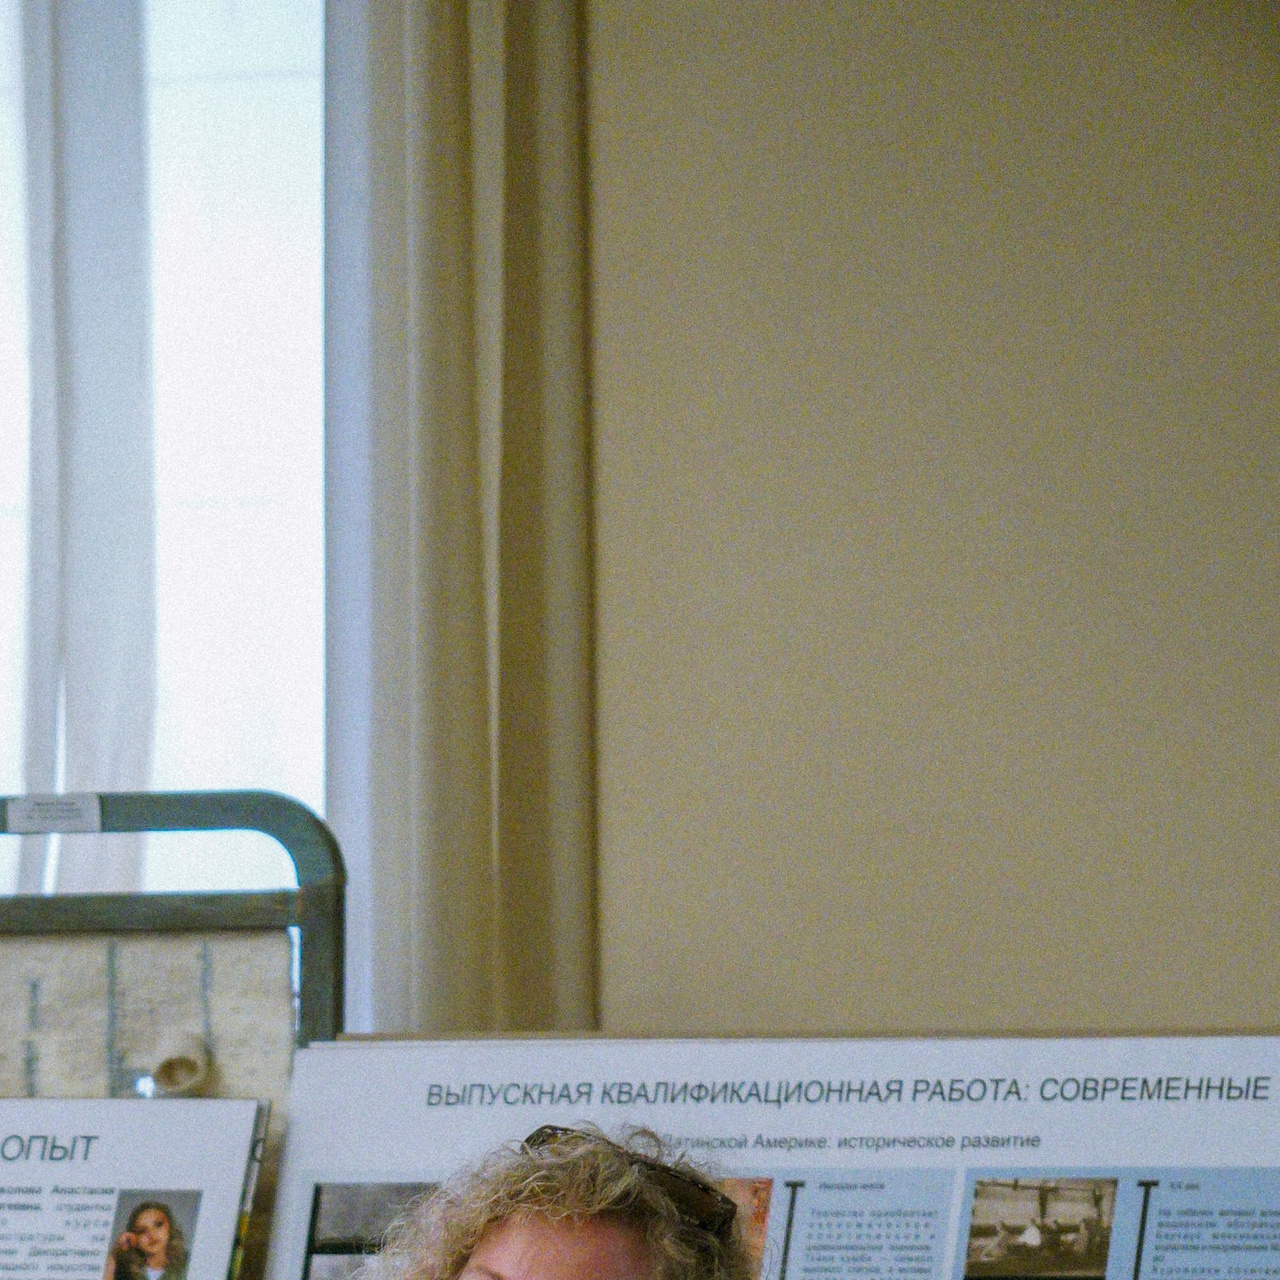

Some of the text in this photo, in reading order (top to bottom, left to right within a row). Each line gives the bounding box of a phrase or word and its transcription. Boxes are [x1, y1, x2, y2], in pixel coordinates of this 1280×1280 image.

[427, 1075, 1270, 1108] ВЫПУСКНАЯ КВАЛИФИКАЦИОННАЯ РАБОТА: СОВРЕМЕННЫЕ
[0, 1134, 99, 1161] ОПЫТ
[837, 1134, 955, 1150] историческое
[960, 1134, 1040, 1151] развитие
